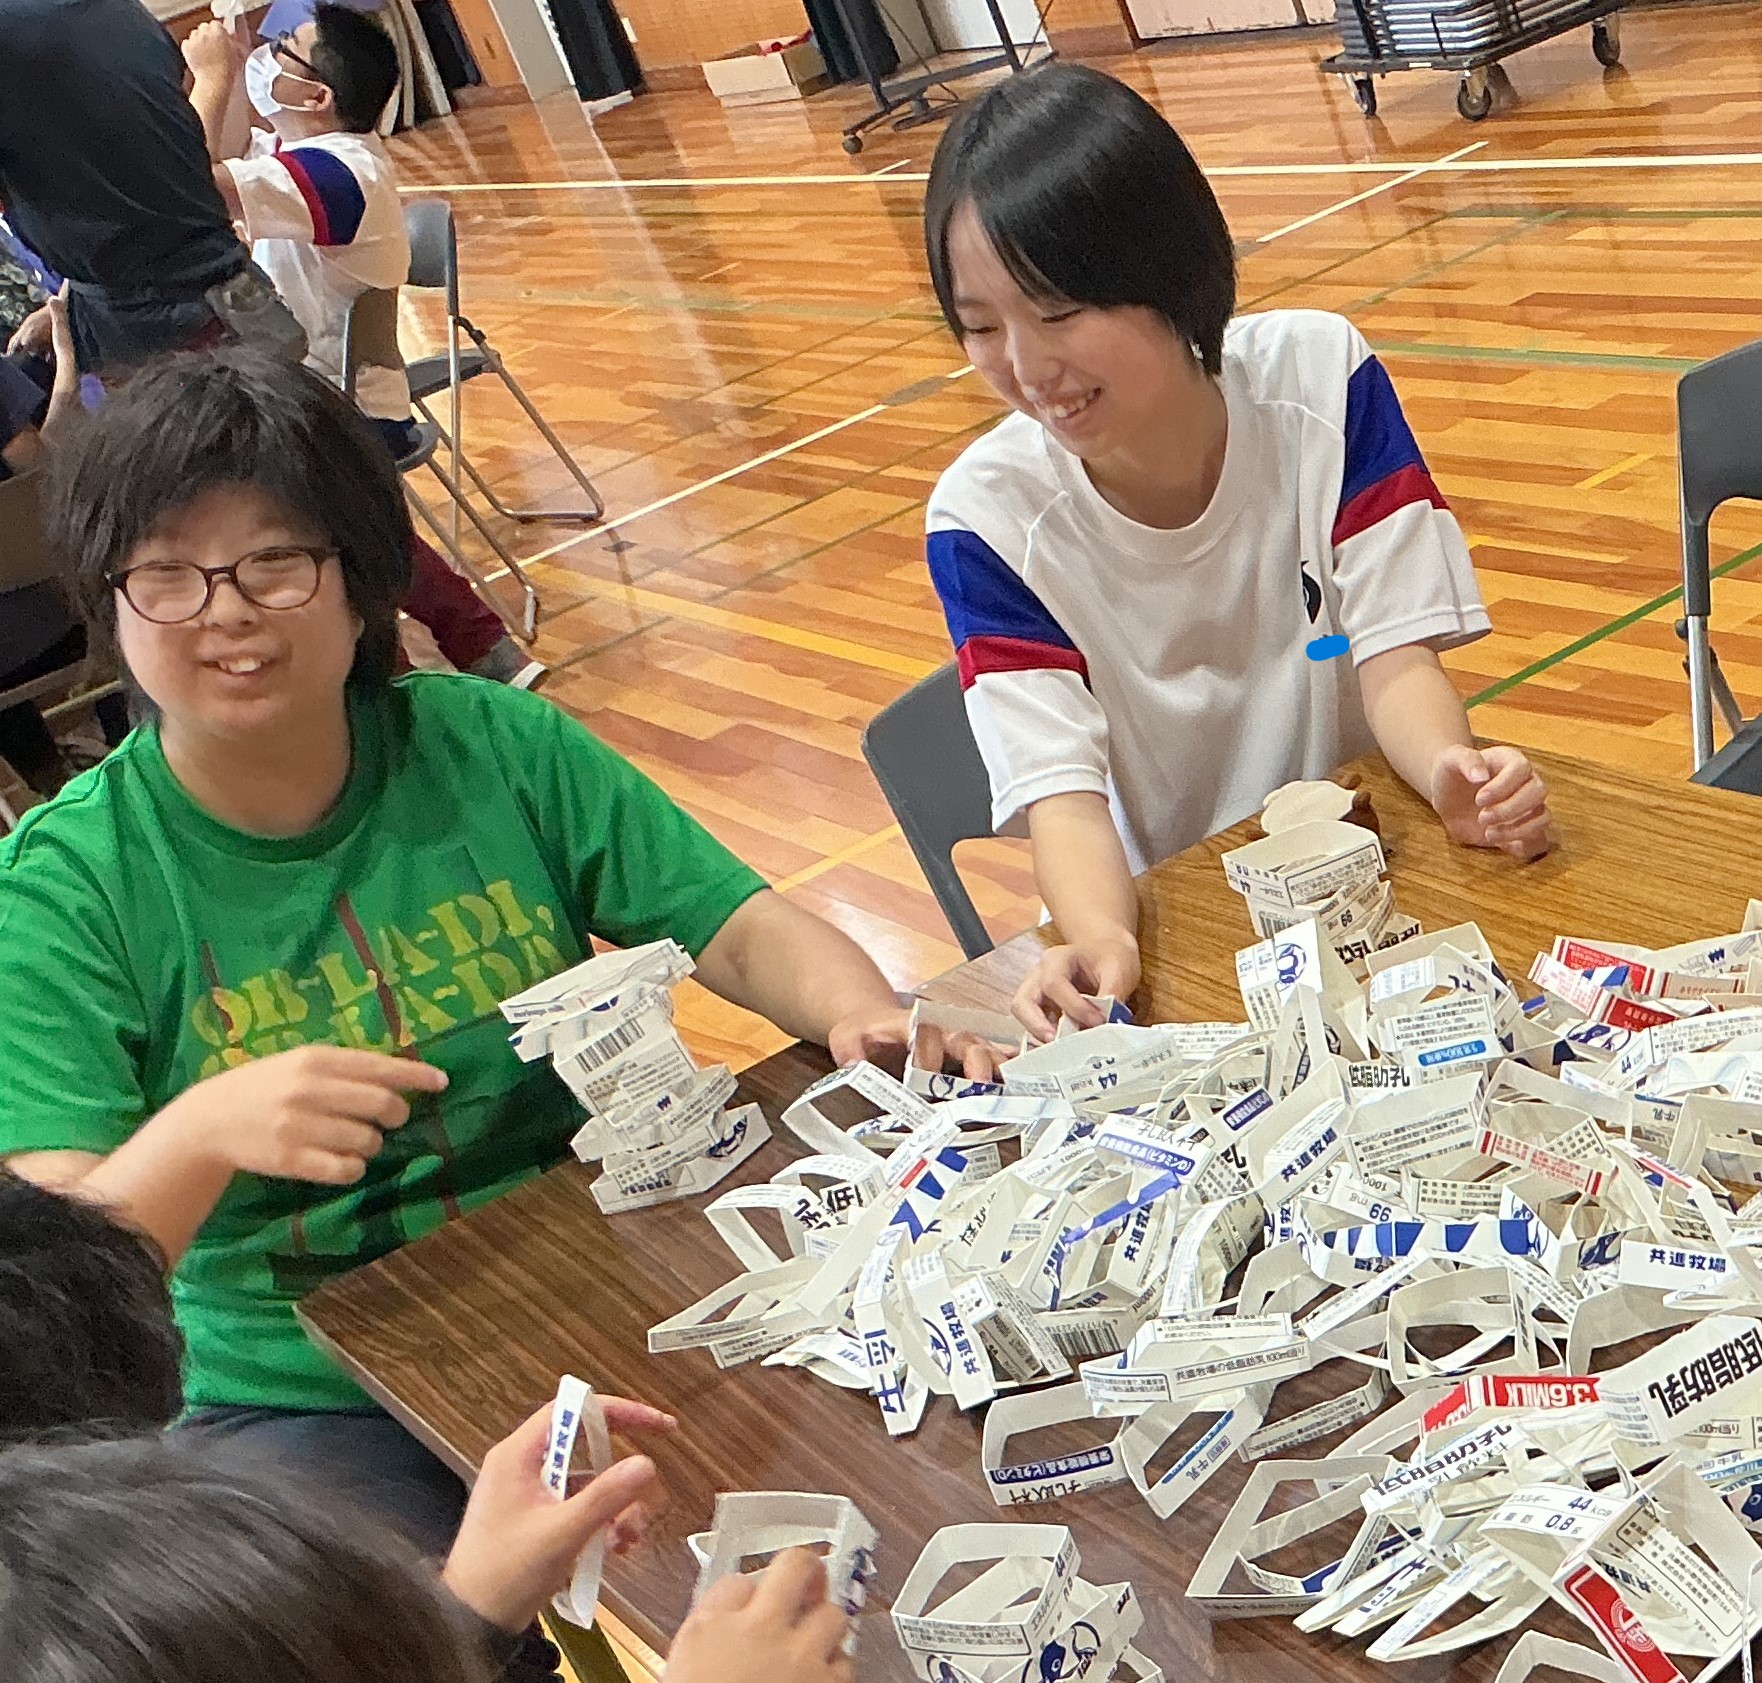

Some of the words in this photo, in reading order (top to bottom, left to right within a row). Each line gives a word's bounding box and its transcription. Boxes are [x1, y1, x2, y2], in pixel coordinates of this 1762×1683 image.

[192, 879, 556, 1048] OB-LA-DI,
[1098, 1072, 1118, 1090] 44
[1280, 1127, 1339, 1181] 共進牧場
[1368, 1202, 1392, 1223] 99
[1648, 1247, 1728, 1274] 共進牧場
[938, 1300, 981, 1376] 共進牧場
[1566, 1494, 1593, 1512] 44
[1544, 1514, 1572, 1531] 0.8
